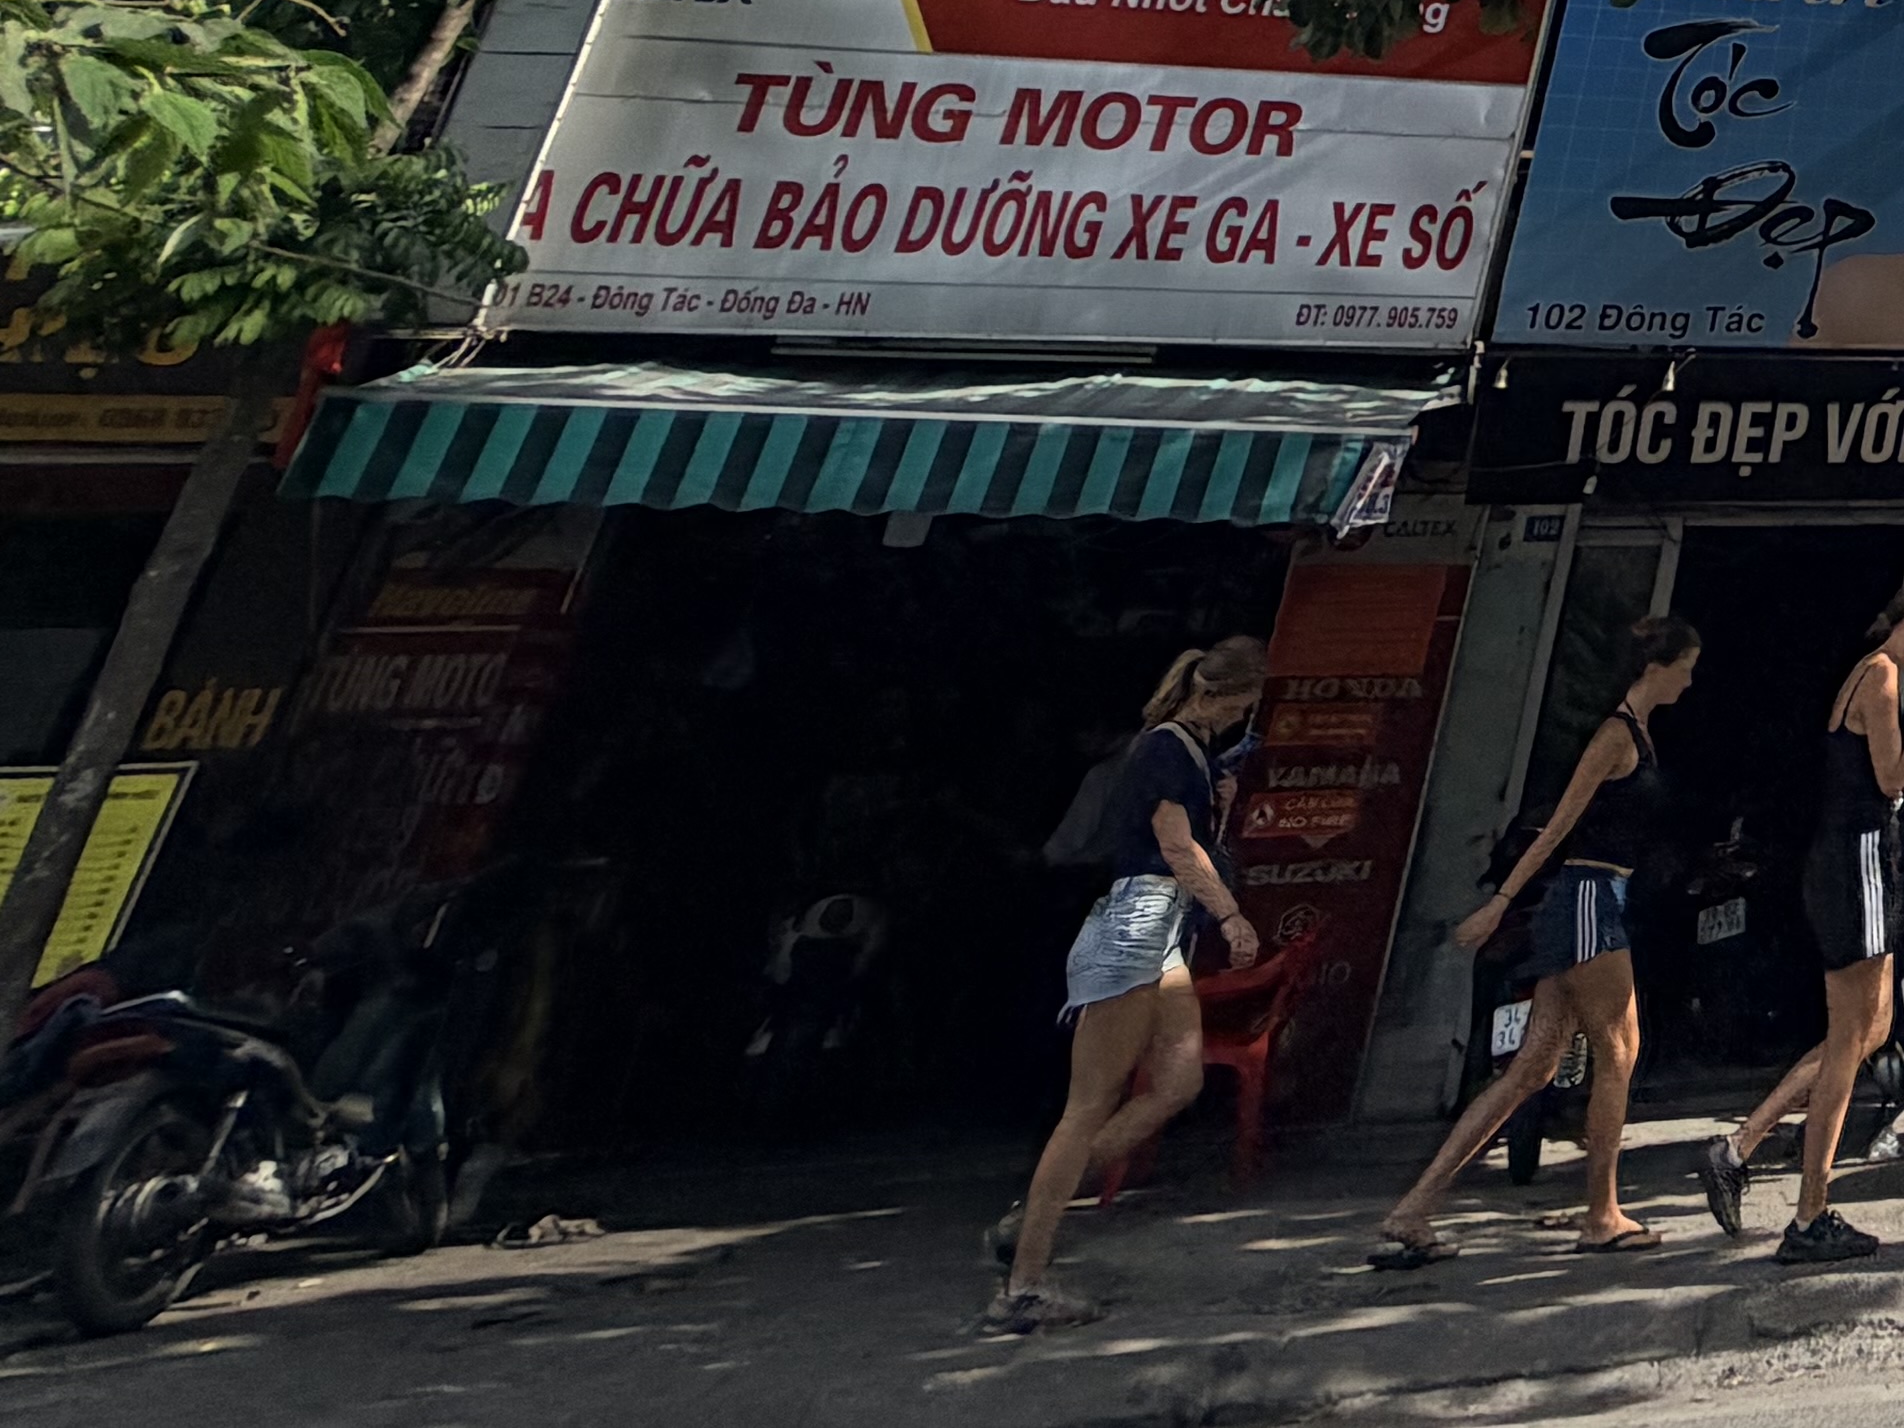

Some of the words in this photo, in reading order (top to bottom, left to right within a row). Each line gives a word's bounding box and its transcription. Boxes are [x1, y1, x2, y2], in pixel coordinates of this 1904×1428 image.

[734, 59, 977, 144] TÙNG
[1000, 87, 1303, 158] MOTOR
[1644, 20, 1797, 147] Tóc
[570, 154, 743, 248] CHỮA
[753, 154, 888, 254] BẢO
[894, 170, 1108, 260] DƯỠNG
[1112, 193, 1198, 262] XE
[1205, 196, 1280, 265] GA
[1315, 200, 1396, 269] XE
[1402, 179, 1489, 271] SỐ
[1611, 161, 1875, 338] Đẹp
[526, 283, 574, 308] B24
[660, 286, 701, 312] Tác
[718, 287, 779, 319] Đống
[785, 290, 818, 315] Đa
[834, 291, 871, 317] HN
[1527, 302, 1587, 331] 102
[1597, 303, 1691, 339] Đông
[1705, 303, 1766, 333] Tác
[1560, 383, 1678, 465] TÓC
[1689, 400, 1810, 478] ĐẸP
